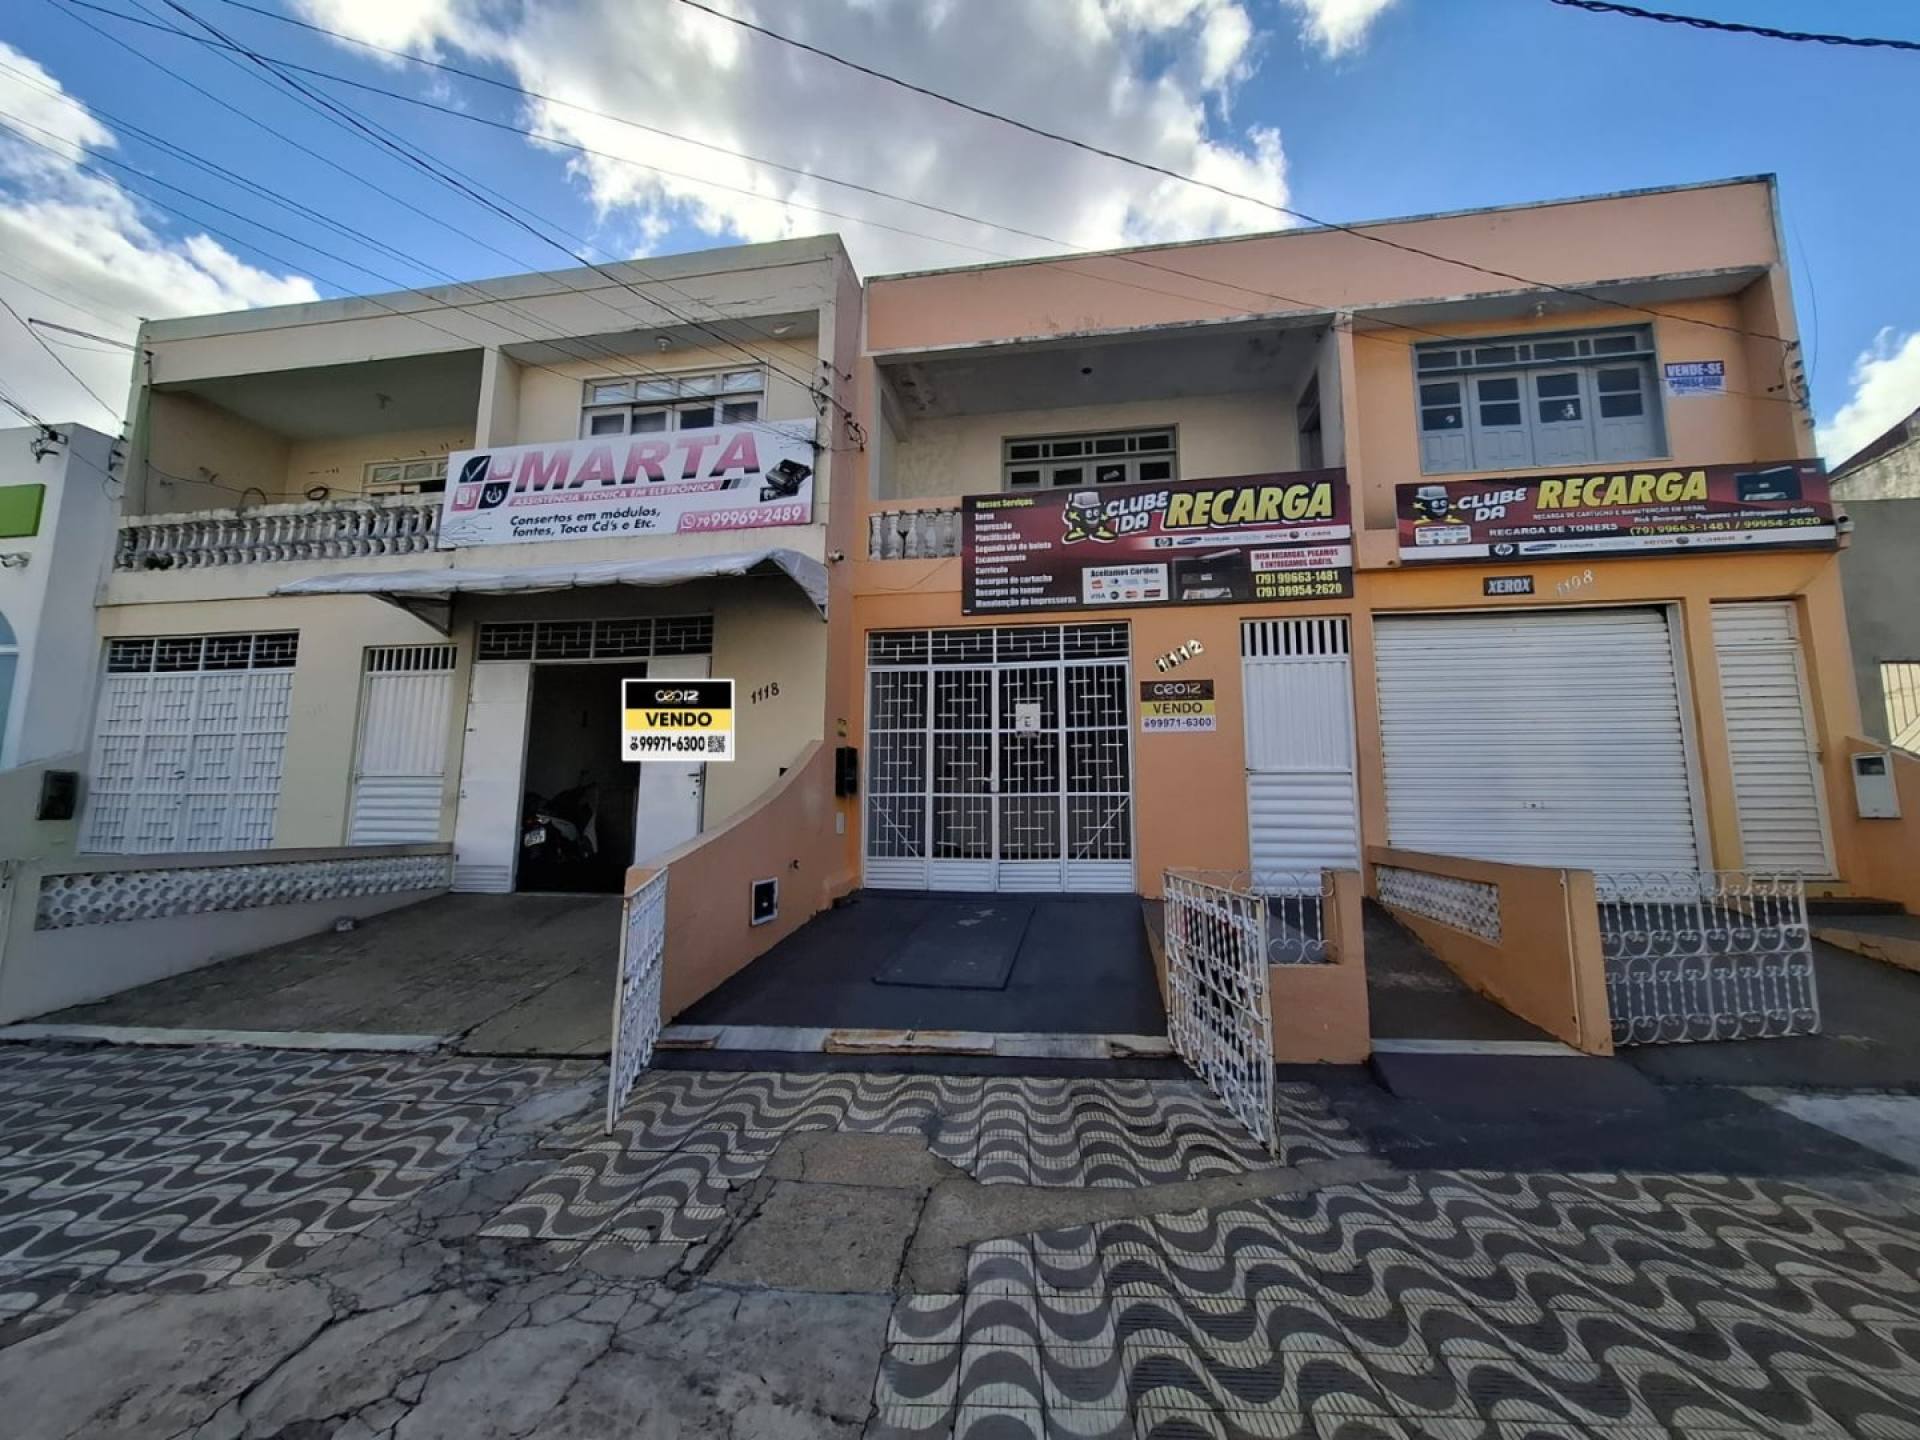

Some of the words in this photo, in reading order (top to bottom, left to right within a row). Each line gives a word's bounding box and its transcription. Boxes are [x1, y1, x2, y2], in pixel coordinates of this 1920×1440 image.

[1667, 363, 1723, 377] VENDE-SE
[514, 431, 760, 493] MARTA
[1458, 487, 1527, 509] CLUBE
[1537, 471, 1708, 509] RECARGA
[1106, 492, 1168, 517] CLUBE
[1166, 483, 1333, 527] RECARGA
[1475, 505, 1506, 522] DA
[510, 514, 572, 526] Consertos
[576, 512, 597, 522] em
[600, 506, 661, 519] módulos,
[711, 506, 802, 526] 99969-2489
[1119, 512, 1149, 533] DA
[512, 526, 555, 537] fontes,
[560, 523, 588, 534] Toca
[592, 520, 617, 532] Cd's
[622, 522, 630, 530] e
[634, 518, 656, 529] Etc.
[1489, 527, 1546, 537] RECARGA
[1549, 525, 1565, 534] DE
[1568, 523, 1618, 533] TONERS
[1488, 578, 1531, 593] XEROX
[1155, 639, 1205, 673] 1112
[751, 682, 780, 704] 1118
[1153, 702, 1203, 714] VENDO
[1150, 717, 1212, 729] 99971-6300
